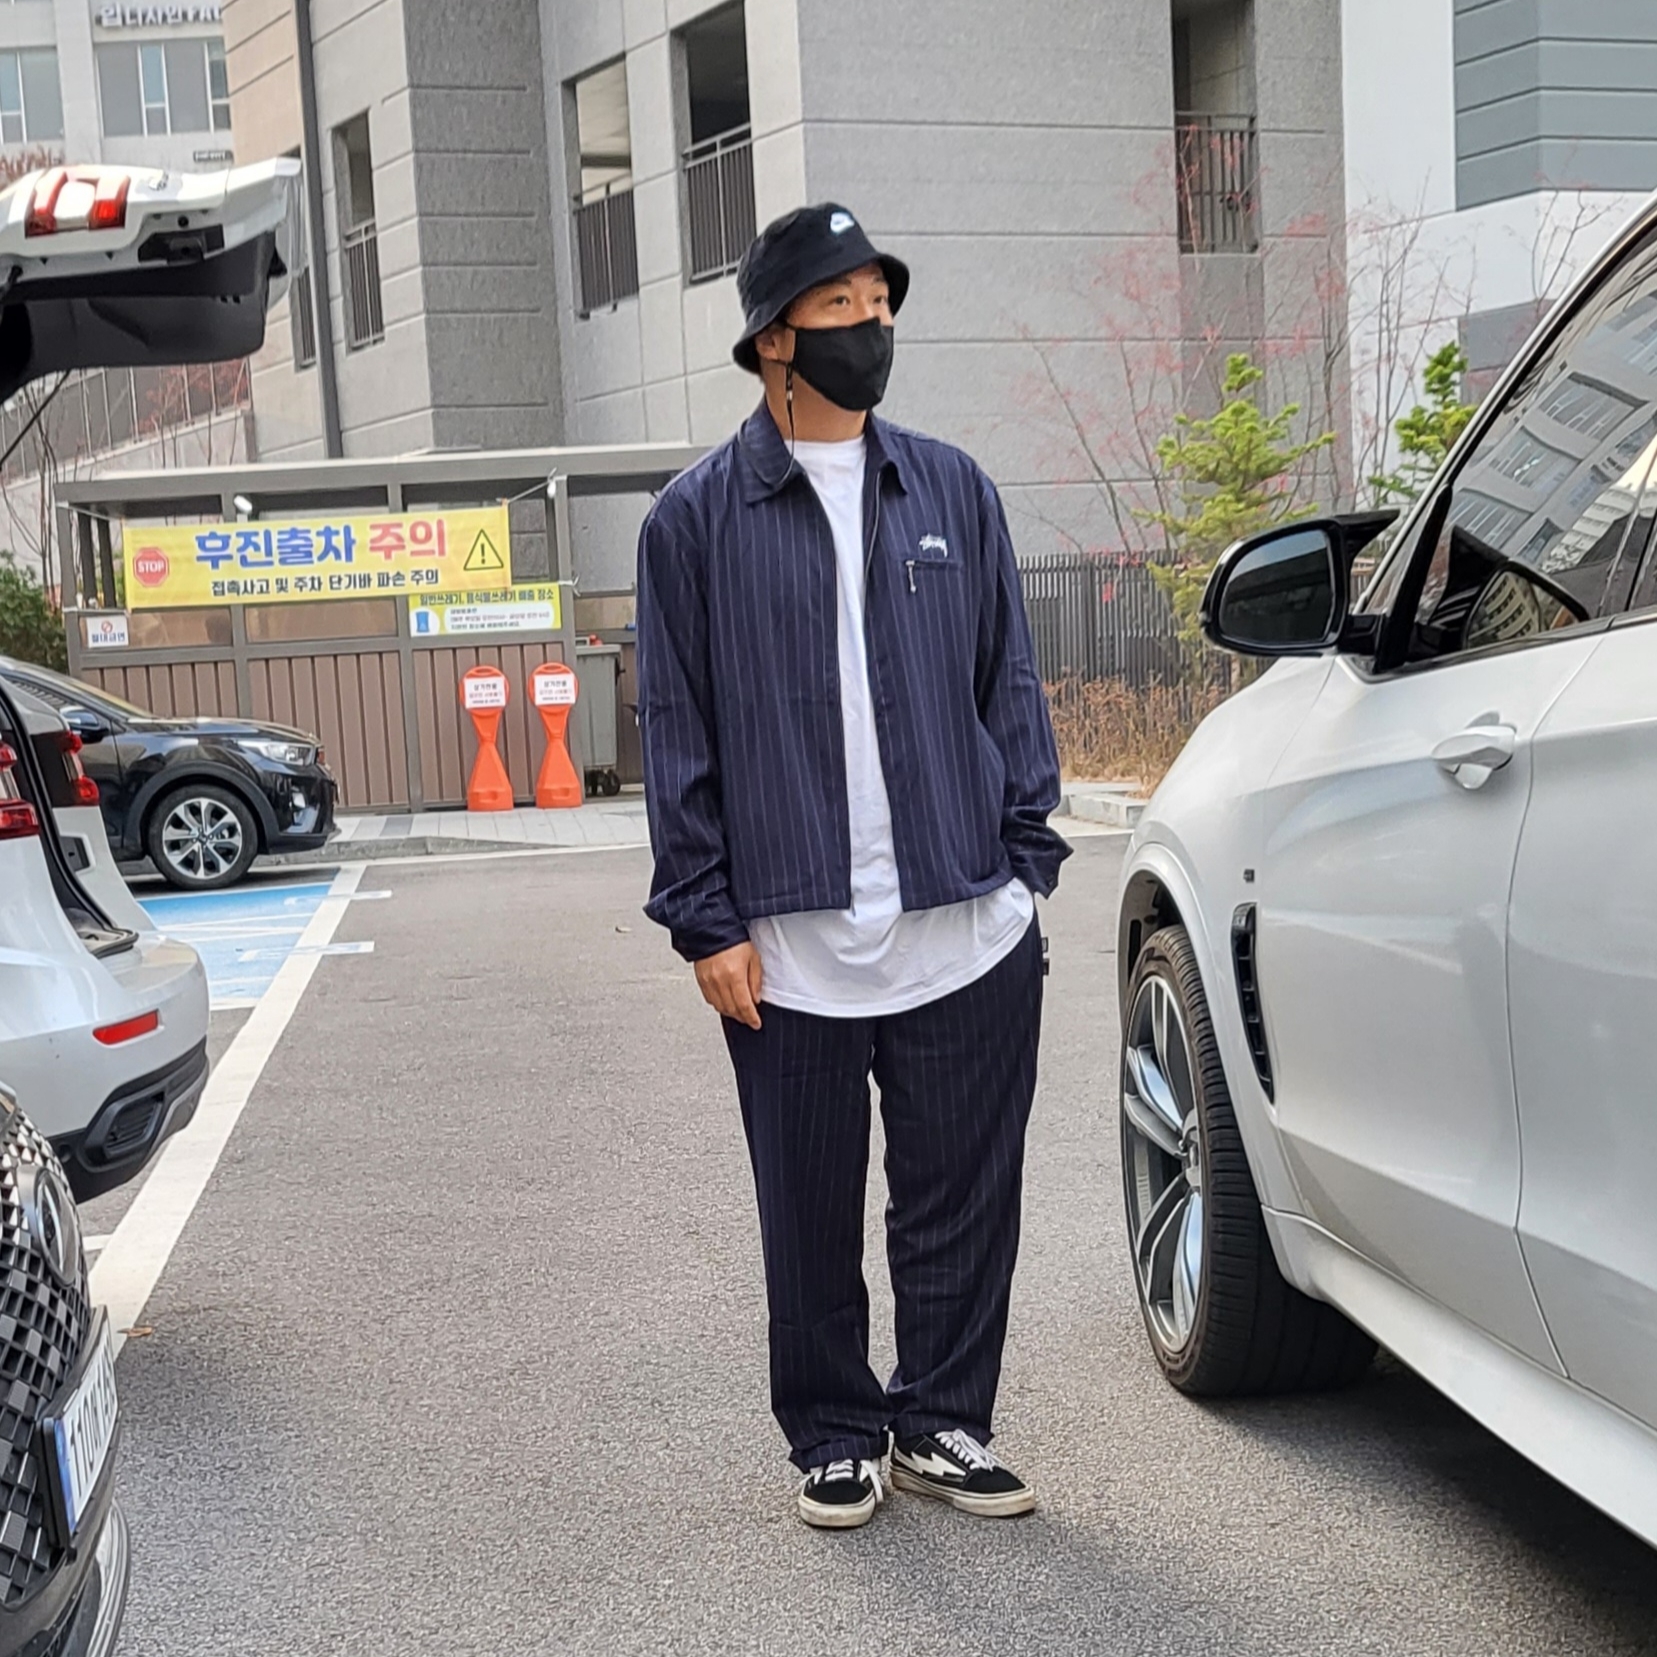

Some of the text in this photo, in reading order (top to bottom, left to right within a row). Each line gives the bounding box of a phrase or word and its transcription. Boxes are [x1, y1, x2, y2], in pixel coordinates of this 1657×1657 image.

[195, 519, 447, 570] 후진출차 주의
[137, 561, 165, 573] STOP
[212, 569, 439, 596] 접촉사고 및 주차 단기바 파손 주의
